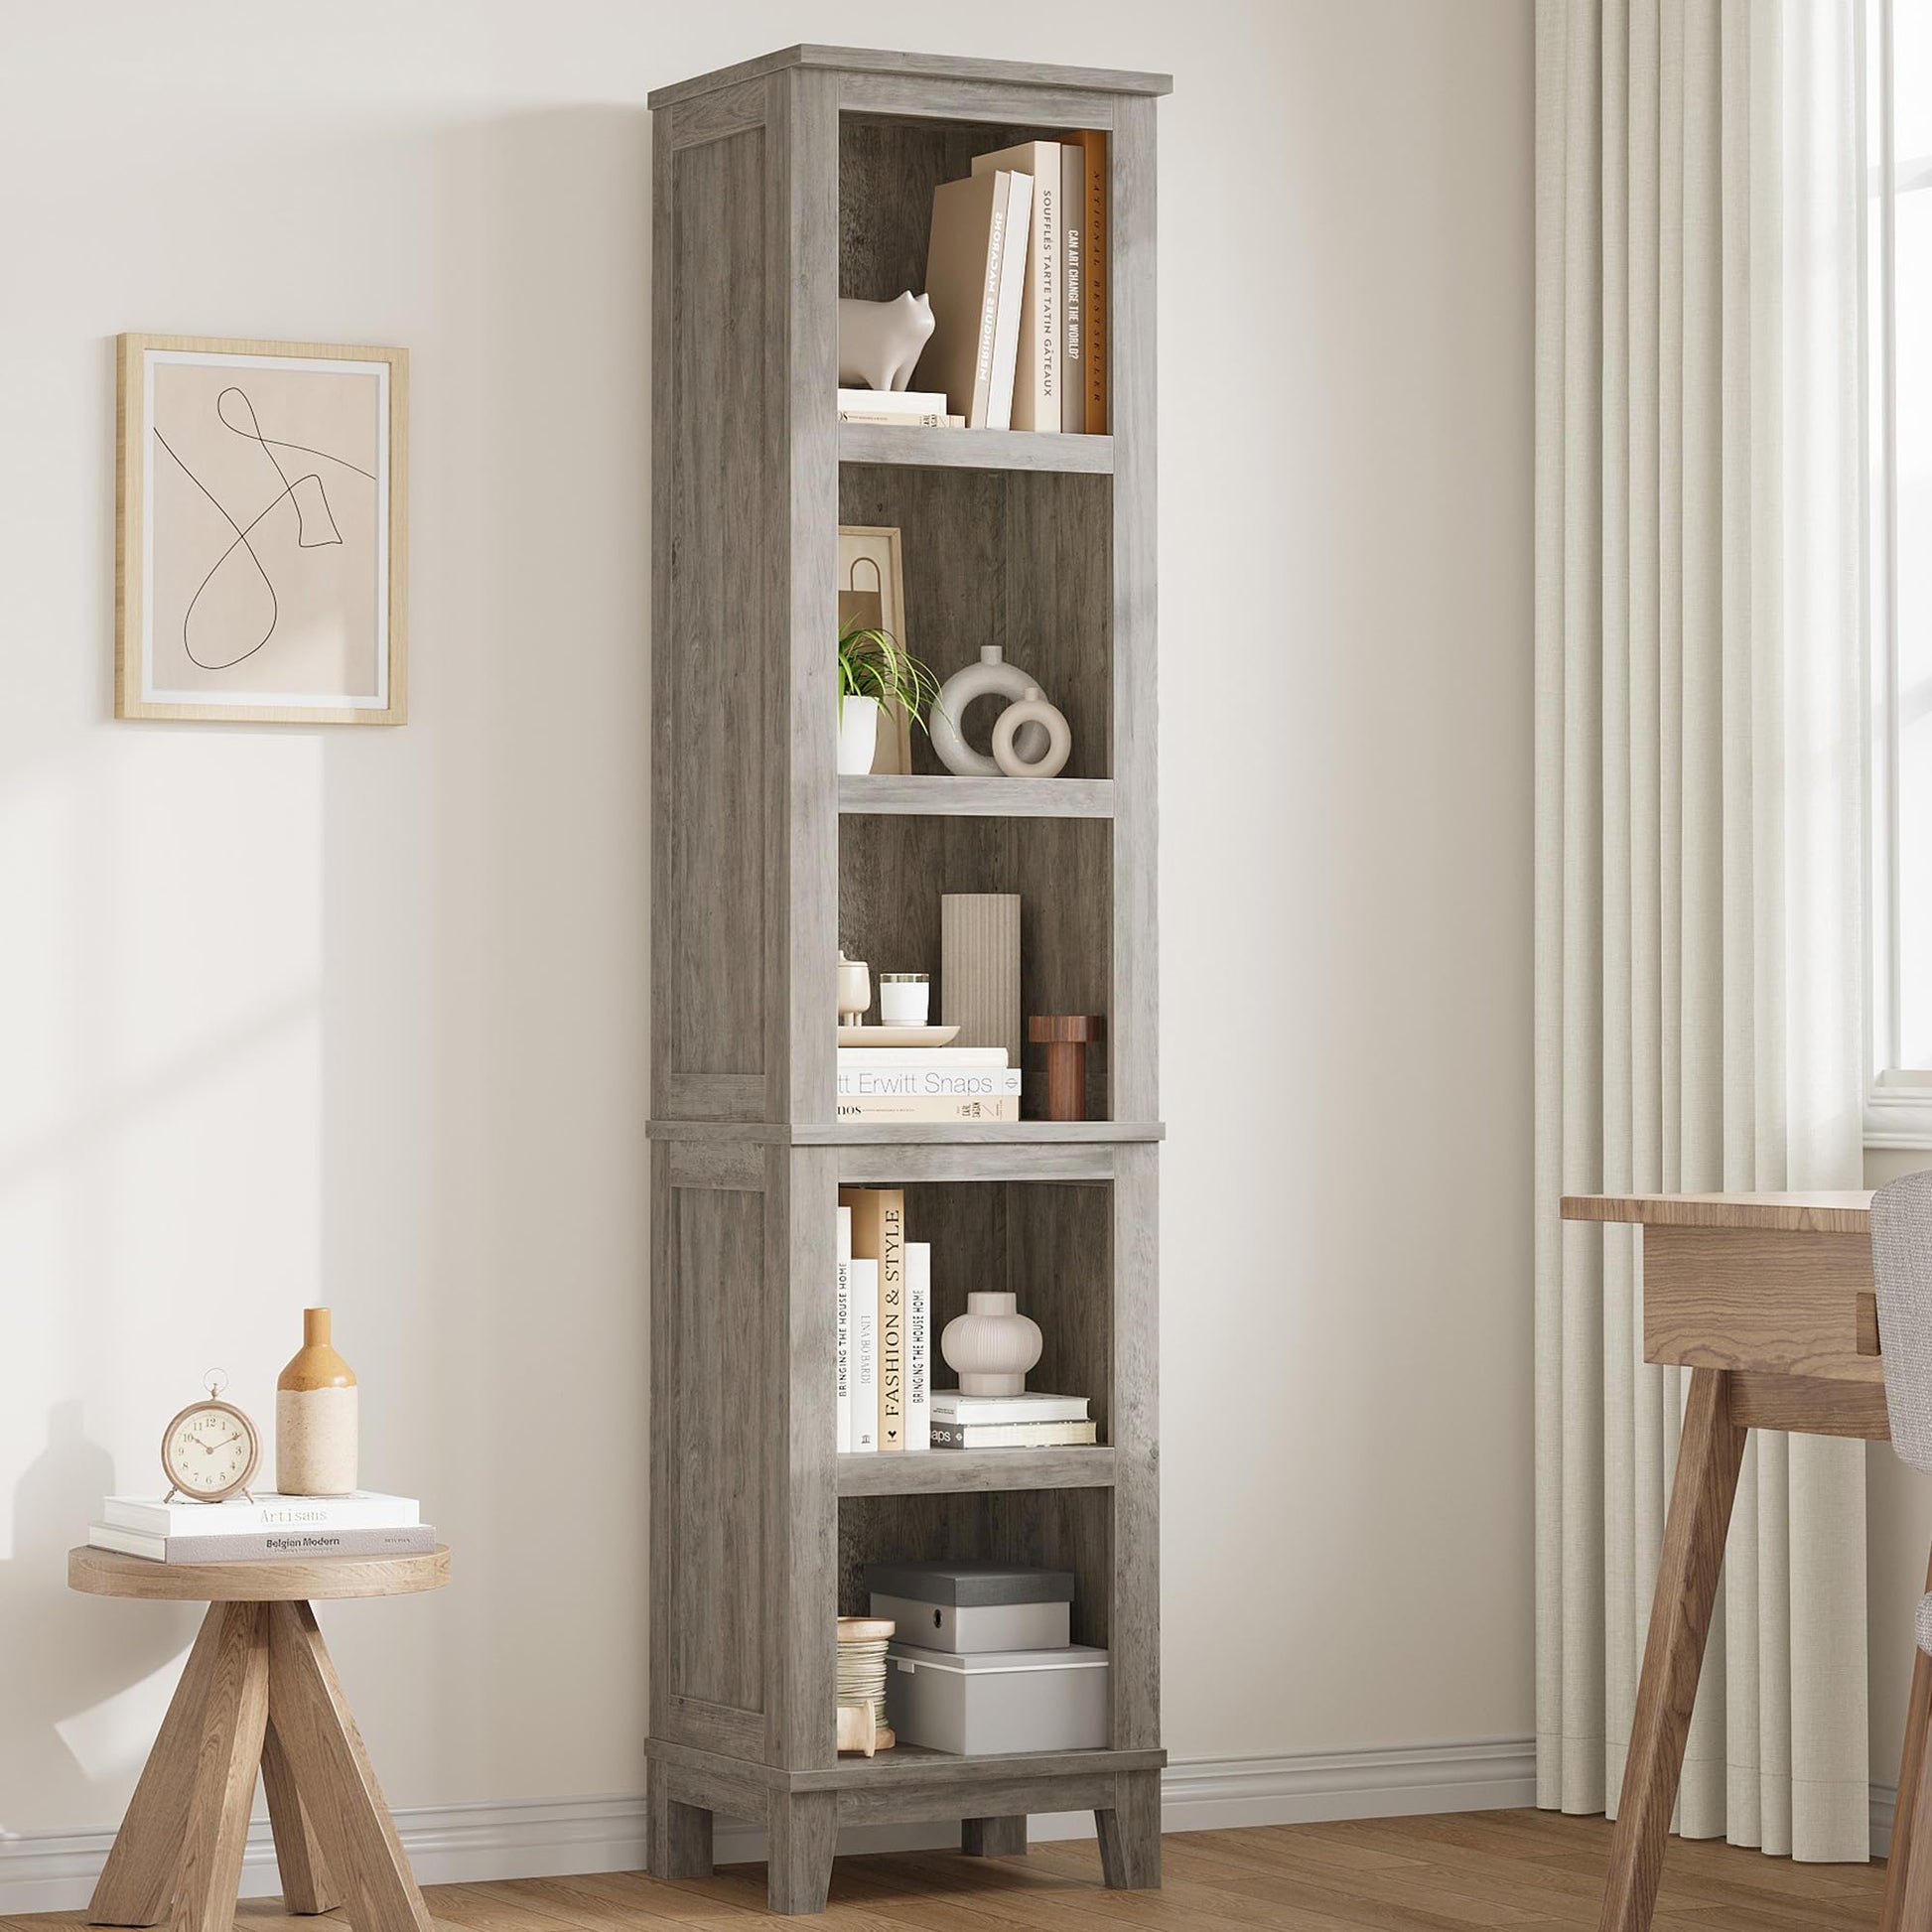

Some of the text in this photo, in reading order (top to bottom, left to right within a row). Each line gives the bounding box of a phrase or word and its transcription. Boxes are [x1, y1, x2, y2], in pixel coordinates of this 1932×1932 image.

[1043, 190, 1054, 396] SOUFFLÉS TARTE TATIN GÂTEAUX
[1067, 229, 1079, 359] CAN ART CHANGE THE WORLD?
[859, 1072, 917, 1094] Erwitt
[924, 1072, 993, 1096] Snaps
[885, 1210, 899, 1416] FASHION & STYLE
[838, 1263, 847, 1397] BRINGING THE HOUSE HOME
[912, 1290, 924, 1404] BRINGING THE HOUSE HOME
[193, 1422, 203, 1431] 11
[207, 1418, 216, 1428] 12
[235, 1446, 242, 1455] 3
[260, 1508, 328, 1524] Artisans
[266, 1538, 302, 1550] Belgian
[303, 1536, 340, 1547] Modern
